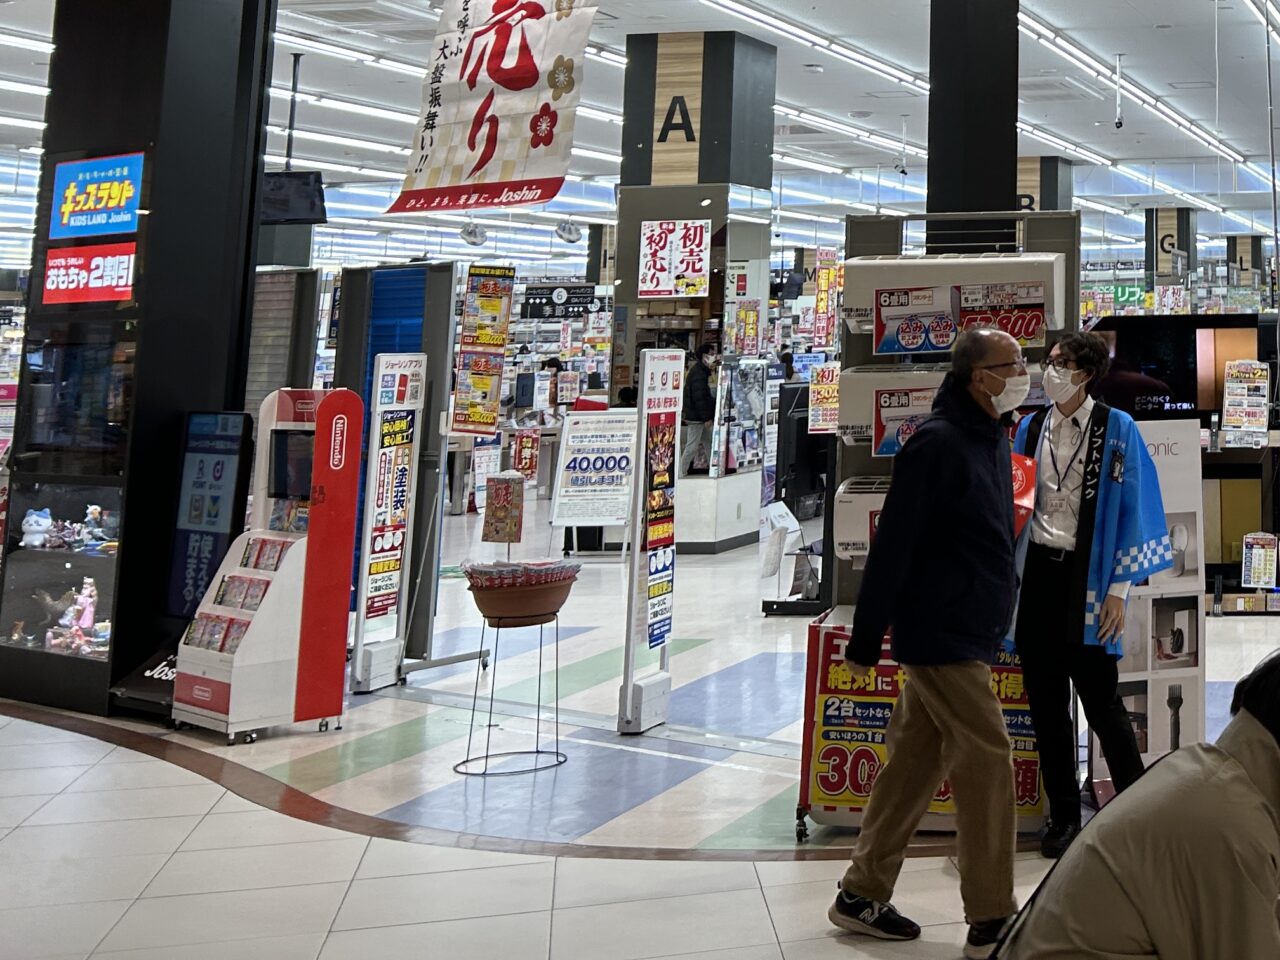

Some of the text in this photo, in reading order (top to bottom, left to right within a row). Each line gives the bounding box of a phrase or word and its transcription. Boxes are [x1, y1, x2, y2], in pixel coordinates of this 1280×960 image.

[657, 95, 697, 143] A
[61, 180, 135, 226] キッズランド
[492, 185, 542, 205] Joshin
[1017, 193, 1036, 211] B
[70, 211, 131, 226] KIDS LAND Joshin
[679, 223, 704, 273] 初売
[1160, 233, 1175, 254] G
[645, 231, 668, 288] 初売り
[804, 268, 817, 282] M
[880, 292, 908, 306] 6畳用
[901, 320, 953, 333] 込み 込み
[385, 360, 422, 370] ジョーシンアプリ
[880, 393, 909, 407] 6畳用
[333, 419, 344, 465] Nintendo
[1085, 426, 1104, 499] ソフトバンク
[393, 466, 408, 510] 塗装
[826, 697, 891, 718] 2台セットなら
[829, 731, 883, 743] 安いほうの1台
